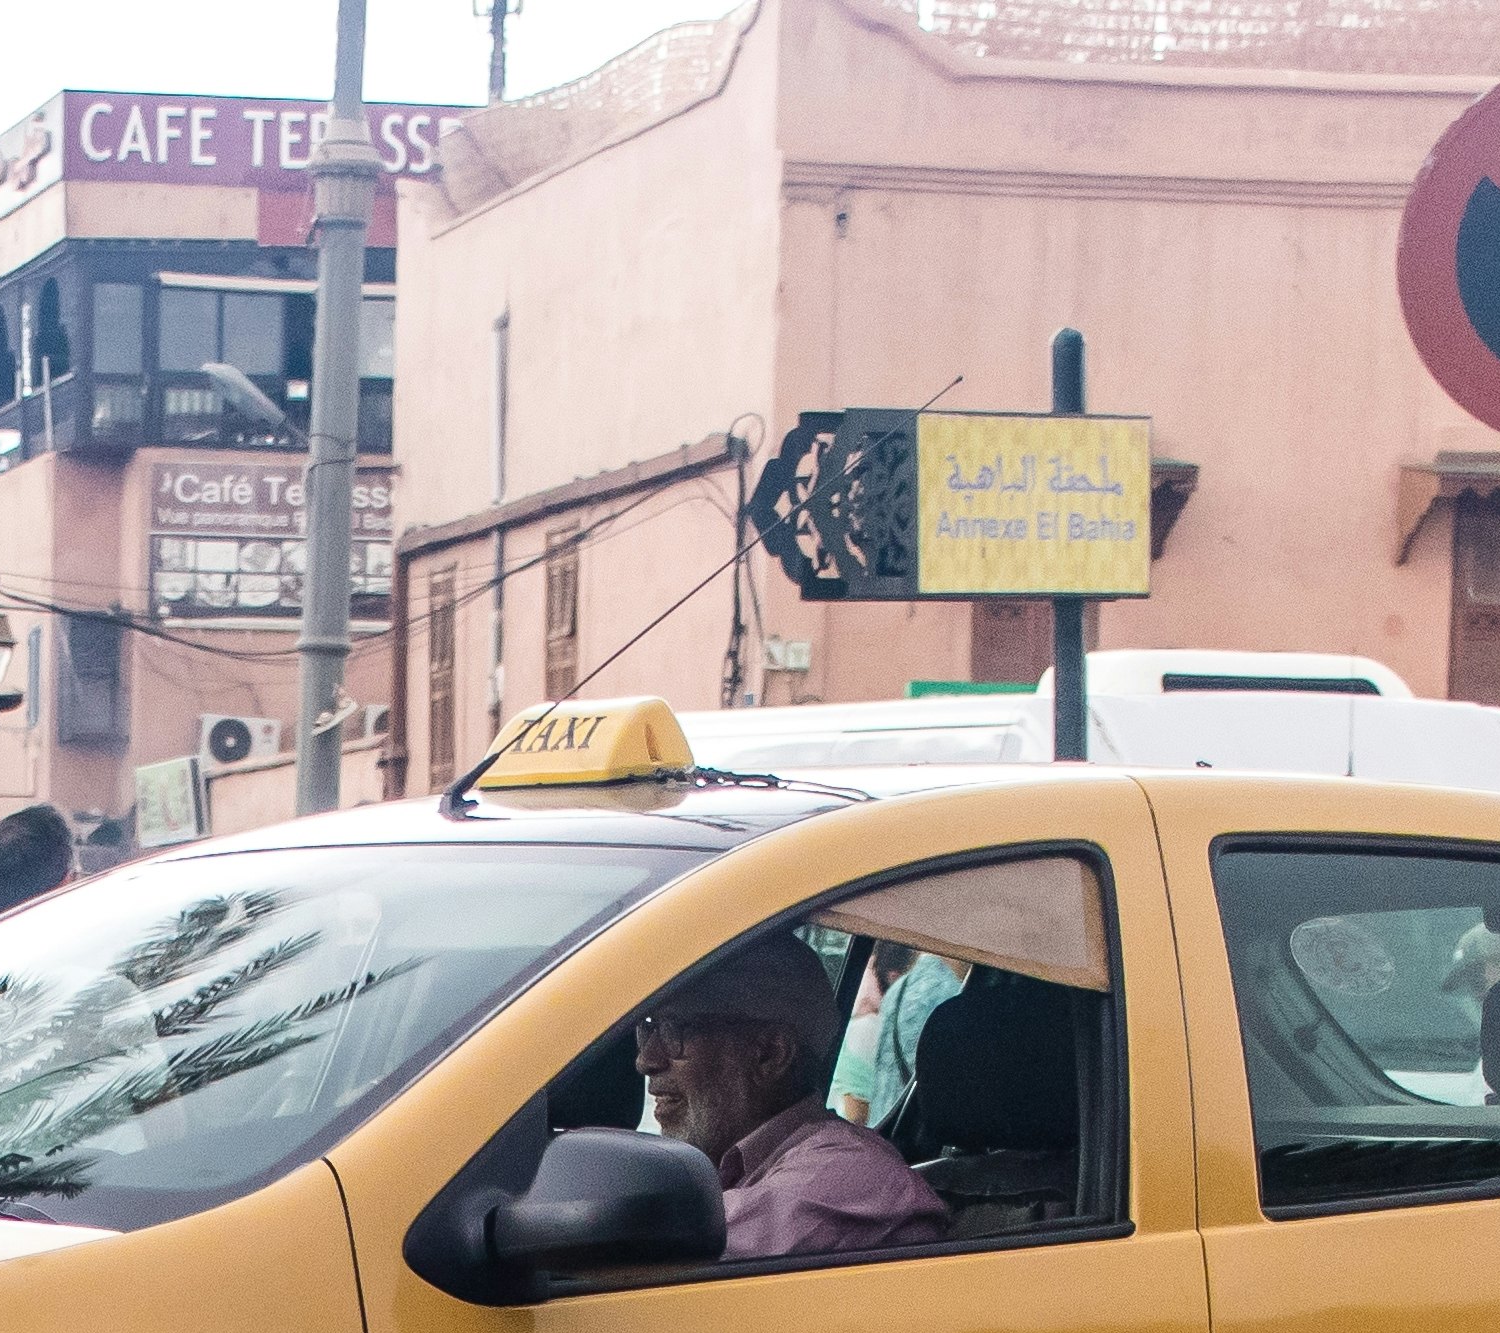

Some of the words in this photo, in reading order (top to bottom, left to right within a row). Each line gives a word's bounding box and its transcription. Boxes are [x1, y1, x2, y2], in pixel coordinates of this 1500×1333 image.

[80, 103, 218, 166] CAFE
[243, 110, 464, 174] TESS
[936, 511, 1029, 541] Annexe
[1037, 511, 1059, 541] El
[511, 716, 607, 752] TAXI
